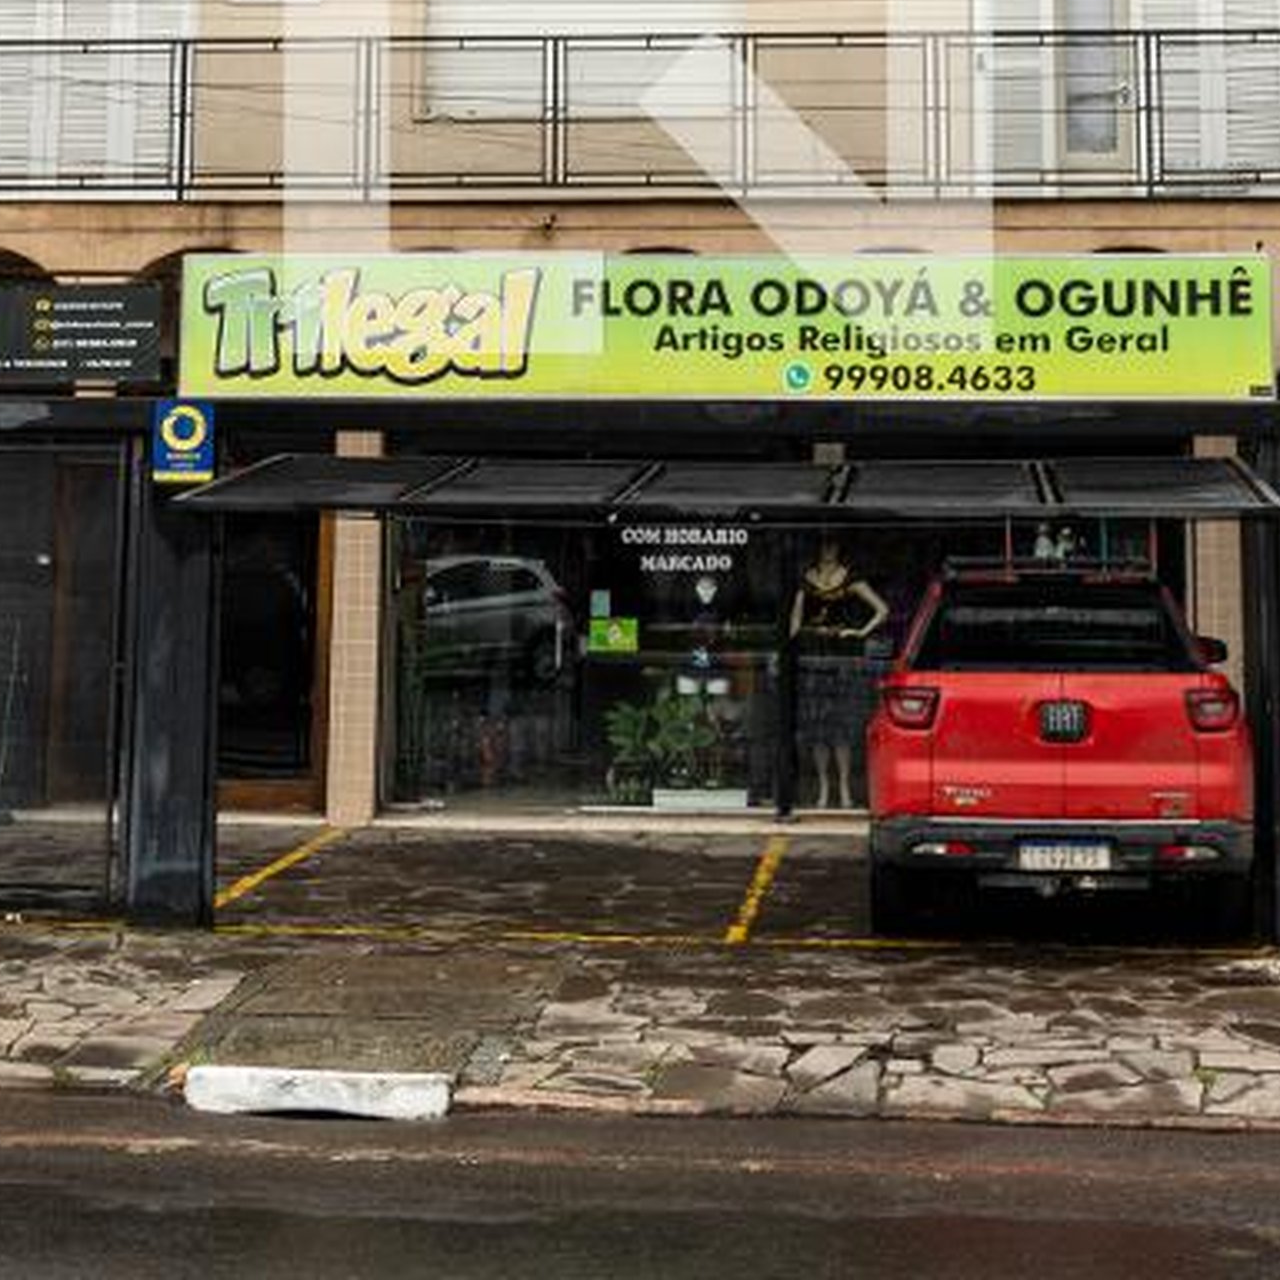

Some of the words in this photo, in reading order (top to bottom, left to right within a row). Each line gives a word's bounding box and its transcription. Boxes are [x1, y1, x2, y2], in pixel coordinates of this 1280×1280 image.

[572, 279, 732, 317] FLORA
[750, 267, 939, 317] ODOYÁ
[959, 280, 992, 317] &
[1015, 266, 1254, 317] OGUNHÊ
[654, 325, 783, 359] Artigos
[798, 324, 982, 359] Religiosos
[995, 334, 1051, 353] em
[1066, 325, 1169, 353] Geral
[824, 365, 1036, 391] 99908.4633
[622, 528, 660, 545] COM
[640, 554, 732, 571] MARCADO
